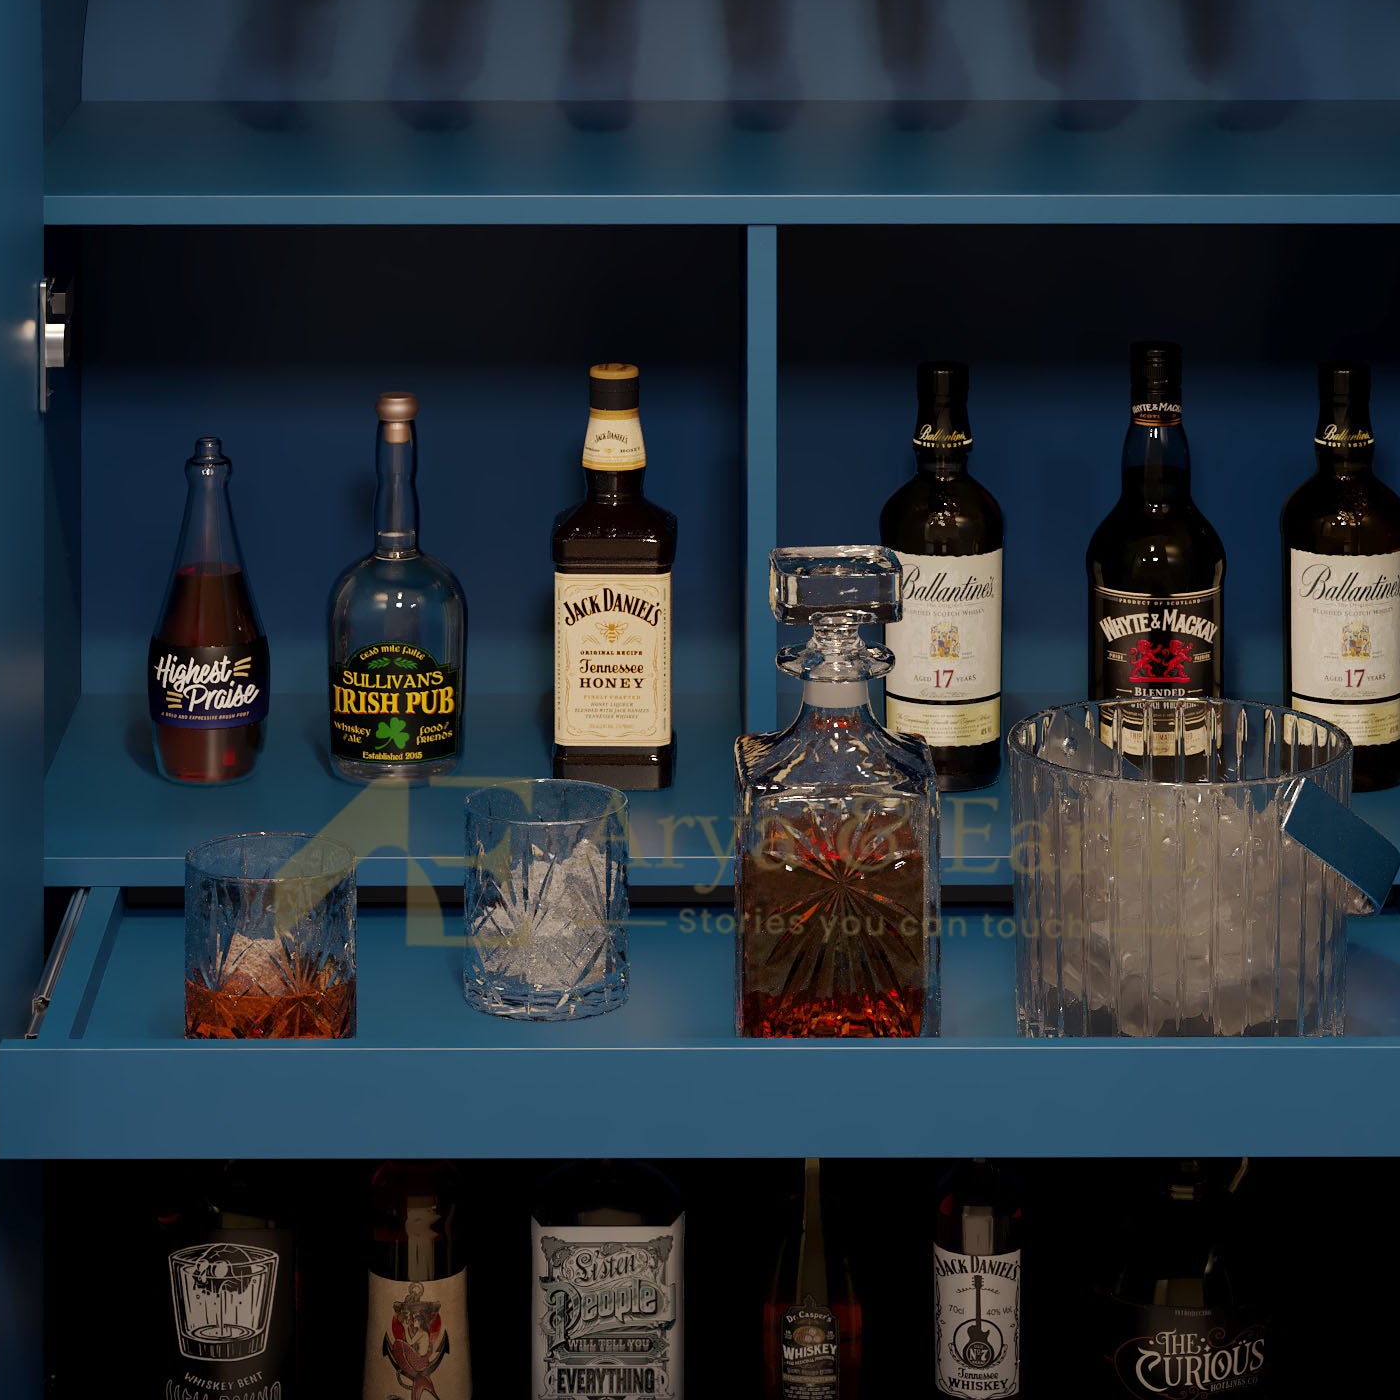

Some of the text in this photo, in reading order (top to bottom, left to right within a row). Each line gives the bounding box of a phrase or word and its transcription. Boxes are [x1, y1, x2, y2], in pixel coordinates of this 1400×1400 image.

[563, 587, 662, 626] JACK DANIEL'S
[1119, 598, 1150, 606] PRODUCT
[154, 653, 233, 692] Highest
[579, 658, 644, 674] Tennessee
[342, 670, 444, 689] SULLIVAN'S
[579, 677, 646, 688] HONEY
[933, 669, 954, 689] 17
[1345, 668, 1366, 688] 17
[182, 680, 260, 712] Praise
[332, 684, 456, 714] IRISH PUB
[1134, 687, 1186, 697] BLENDED
[362, 751, 423, 760] Established 2015
[574, 1250, 635, 1284] Listen
[935, 1254, 1020, 1282] JACK DANIEL'S
[543, 1279, 658, 1344] People
[799, 1310, 832, 1323] Casper's
[948, 1304, 965, 1315] 70cl
[986, 1308, 1001, 1316] 40%
[567, 1337, 651, 1351] WILL TELL YOU
[782, 1343, 838, 1360] WHISKEY
[1155, 1328, 1201, 1356] THE
[184, 1371, 264, 1390] WHISKEY BENT
[557, 1367, 655, 1394] EVERYTHING
[958, 1367, 999, 1380] Tennessee
[948, 1377, 1009, 1391] WHISKEY
